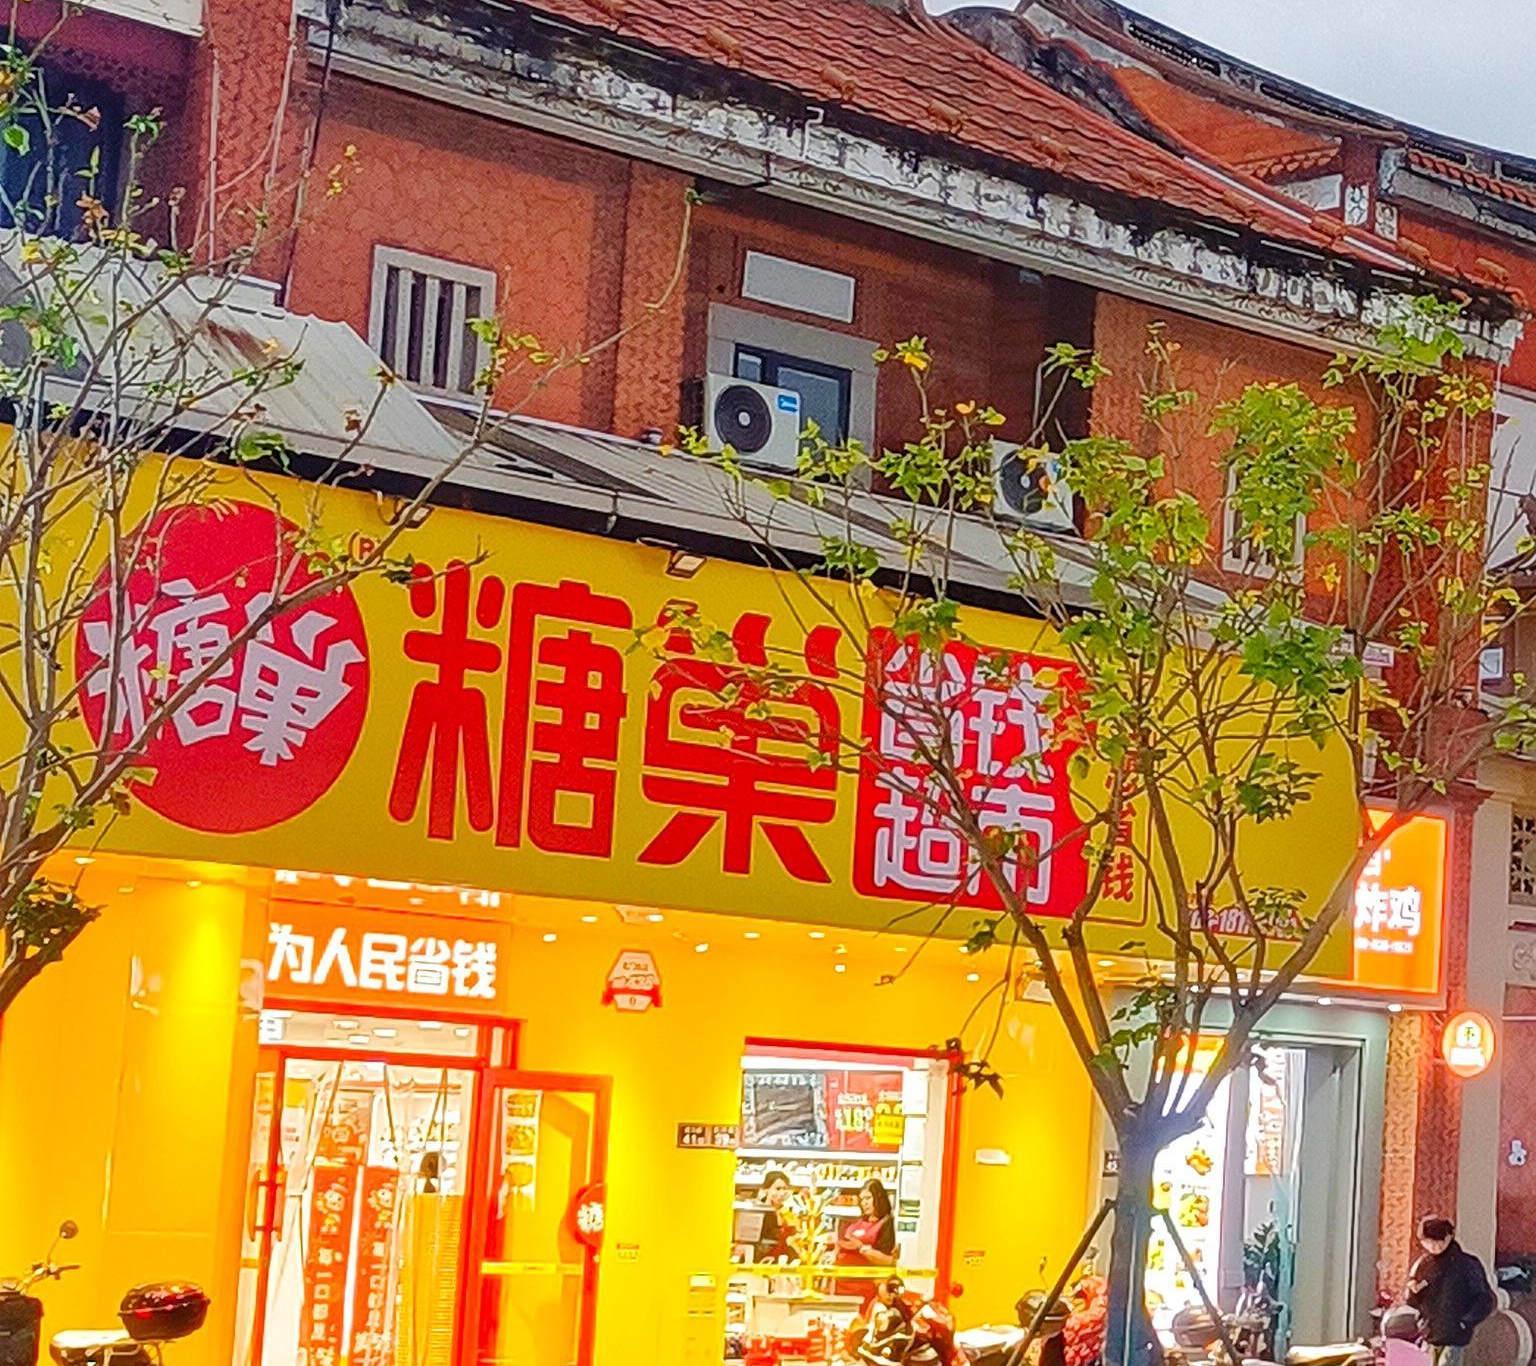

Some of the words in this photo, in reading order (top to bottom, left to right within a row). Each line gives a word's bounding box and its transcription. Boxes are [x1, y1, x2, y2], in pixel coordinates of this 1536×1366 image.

[83, 578, 366, 766] 糖巢
[388, 559, 842, 884] 糖巢
[873, 767, 1055, 905] 超市
[267, 922, 497, 999] 为人民省钱
